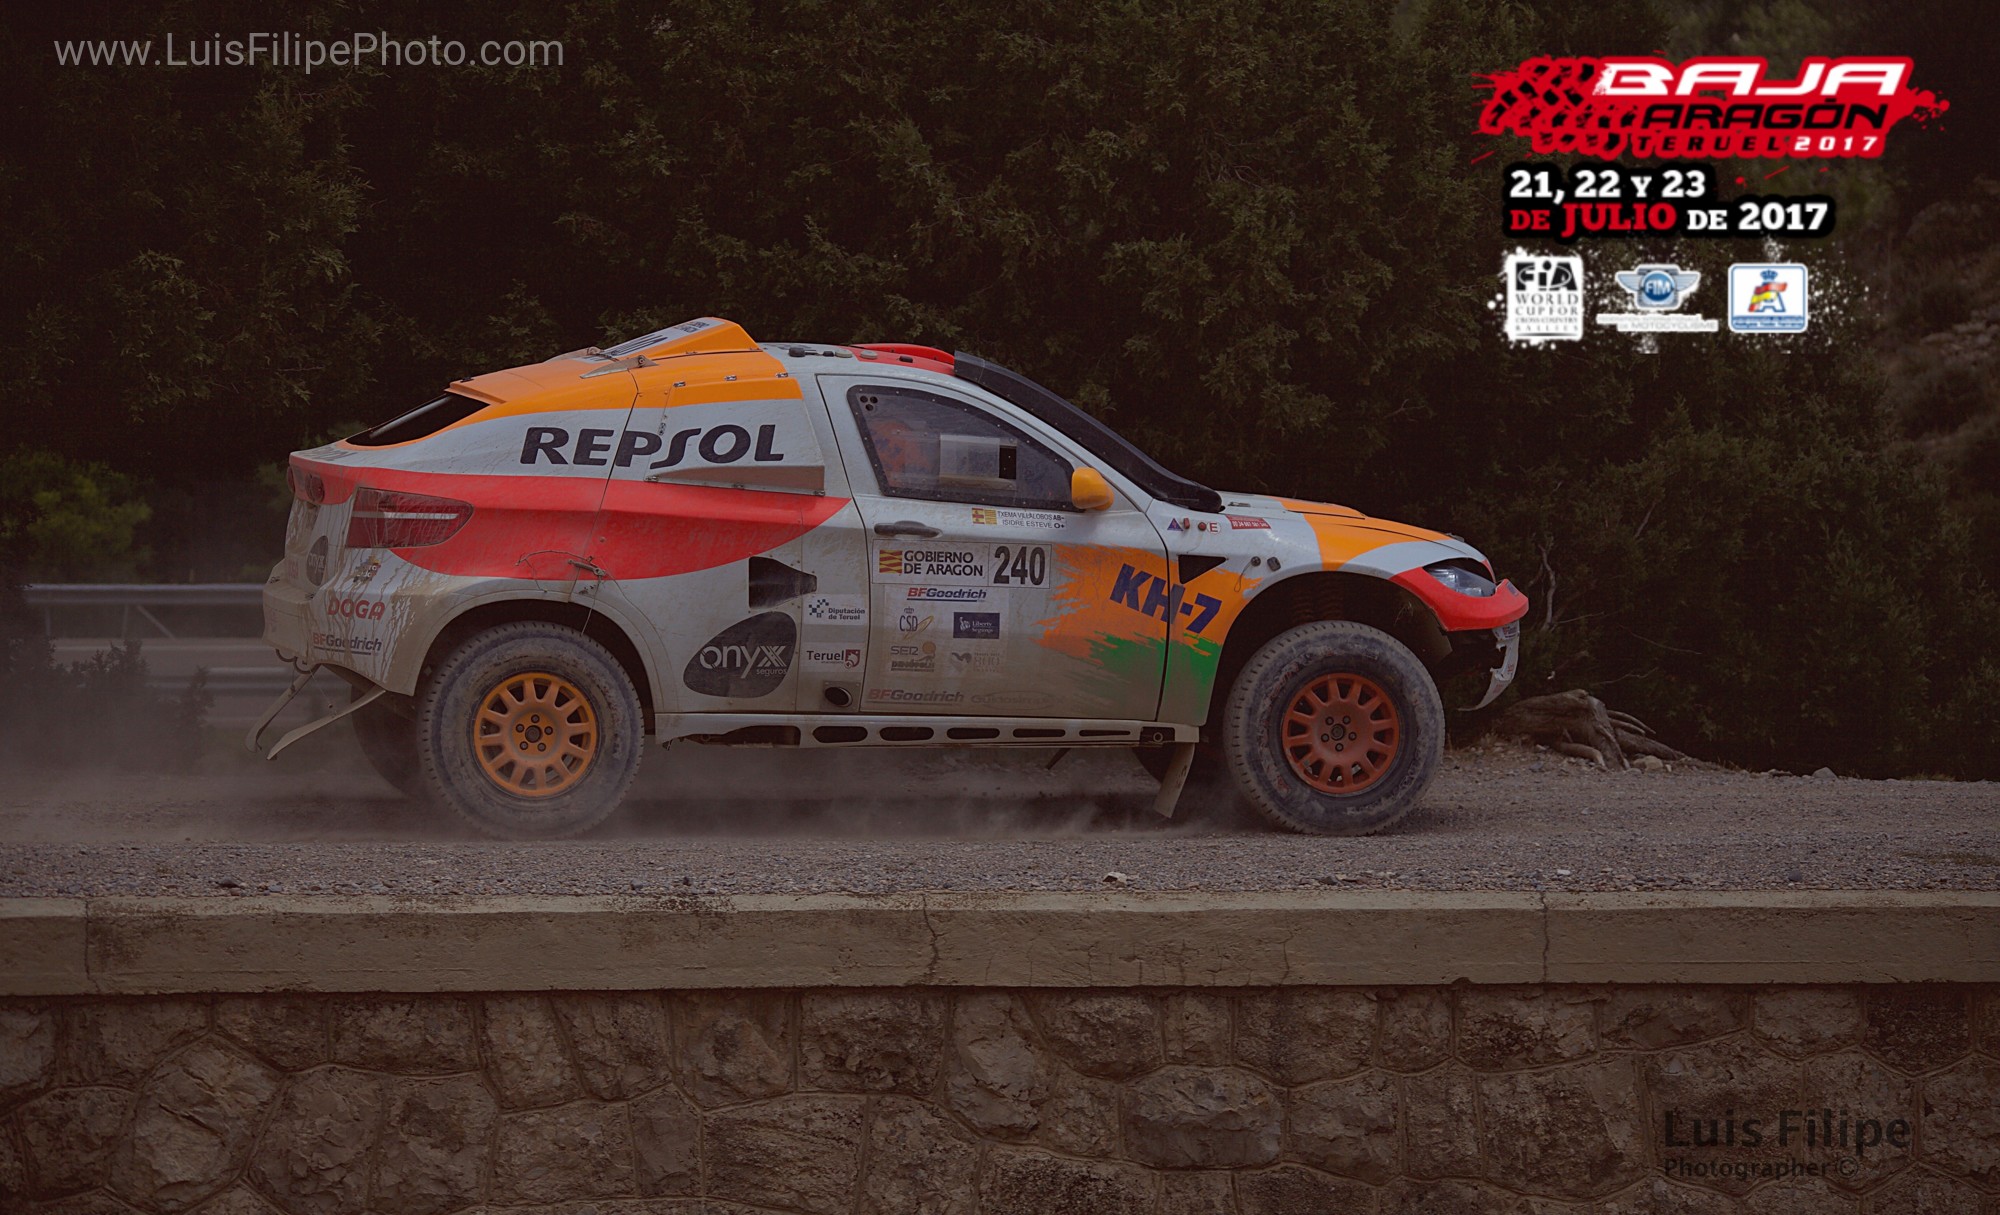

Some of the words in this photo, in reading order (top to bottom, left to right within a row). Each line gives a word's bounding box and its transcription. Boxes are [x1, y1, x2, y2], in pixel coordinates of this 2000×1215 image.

[519, 424, 785, 470] REPSOL
[997, 510, 1018, 519] TXEMA
[1002, 519, 1025, 527] ISIDRE
[1026, 520, 1052, 529] ESTEVE
[1209, 522, 1218, 533] E
[903, 550, 974, 564] GOBIERNO
[903, 563, 922, 575] DE
[992, 545, 1046, 586] 240
[907, 586, 987, 600] BFGoodrich
[1109, 562, 1223, 635] KH-7
[327, 598, 386, 621] DOGA
[828, 606, 866, 615] Diputación
[899, 615, 919, 632] CSD
[972, 620, 993, 628] Liberty
[699, 645, 788, 679] onyx
[806, 650, 844, 661] Teruel
[756, 667, 787, 677] seguros
[867, 688, 965, 704] BFGoodrich
